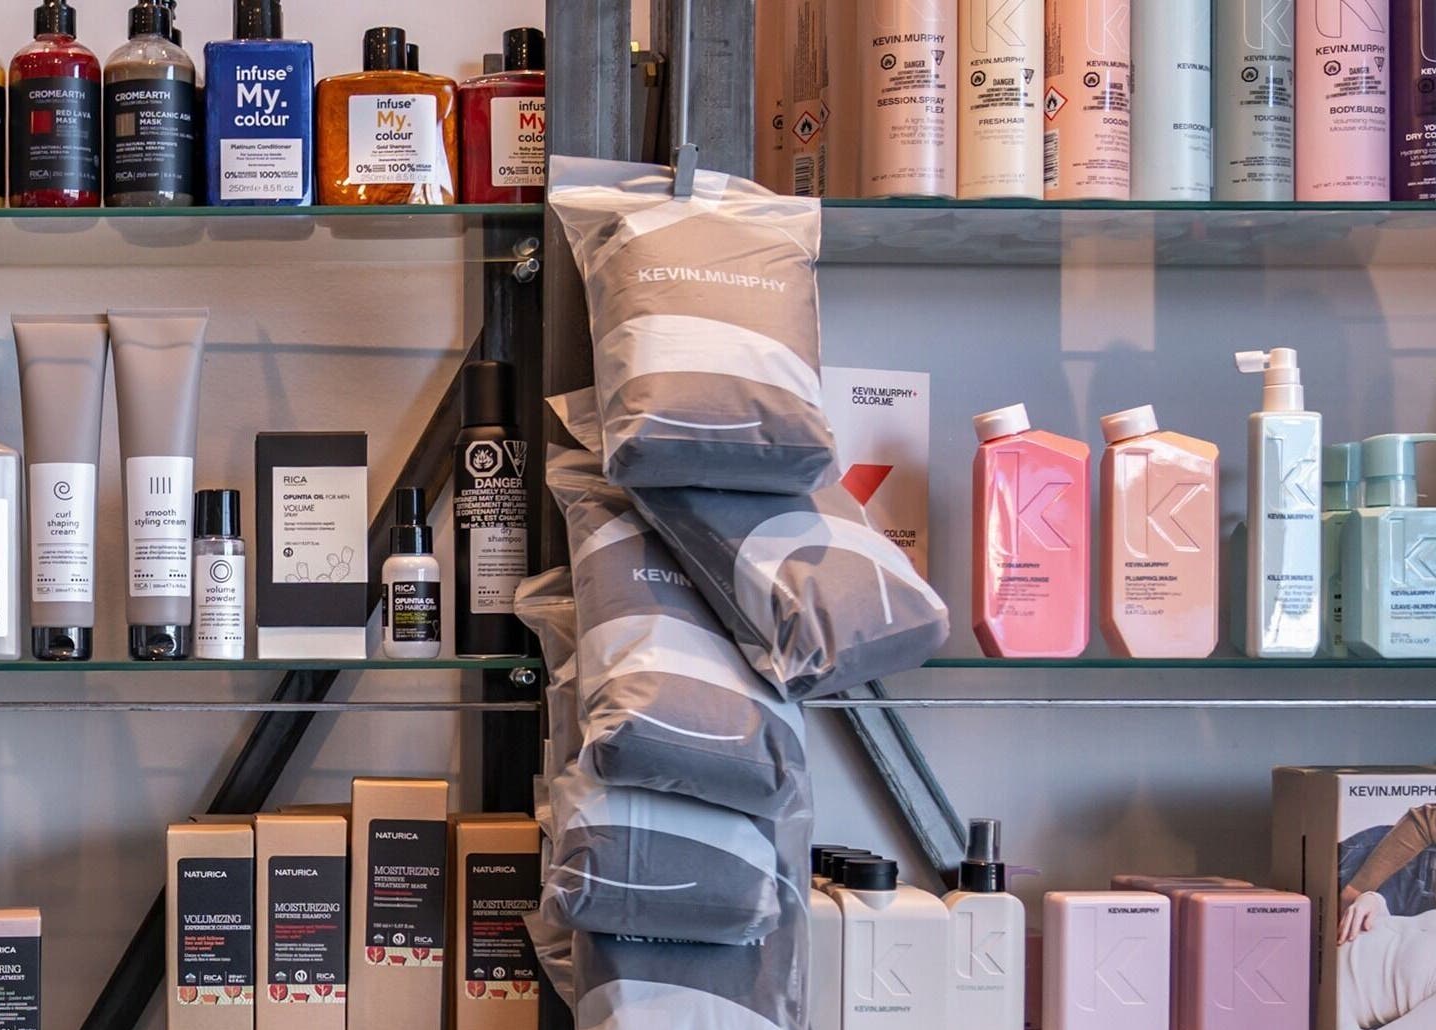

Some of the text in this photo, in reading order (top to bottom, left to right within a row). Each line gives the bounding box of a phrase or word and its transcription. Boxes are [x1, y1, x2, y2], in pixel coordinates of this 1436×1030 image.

[873, 35, 945, 47] KEVIN.MURPHY
[1316, 44, 1386, 56] KEVIN.MURPHY
[237, 65, 287, 81] infuse
[30, 89, 85, 100] CROMEARTH
[116, 92, 170, 101] CROMEARTH
[237, 82, 288, 113] My.
[377, 98, 412, 109] infuse
[140, 111, 176, 120] VOLCANIC
[235, 111, 289, 128] colour
[377, 110, 411, 130] My.
[376, 130, 413, 141] colour
[388, 163, 416, 173] 100%
[638, 267, 786, 293] KEVIN.MURPHY
[475, 477, 522, 488] DANGER
[283, 503, 314, 512] VOLUME
[145, 509, 176, 517] smooth
[47, 520, 80, 529] shaping
[134, 518, 160, 527] styling
[51, 528, 76, 536] cream
[206, 586, 236, 594] volume
[396, 584, 416, 593] RICA
[206, 594, 236, 603] powder
[1349, 785, 1436, 797] KEVIN.MURPH
[375, 832, 418, 840] NATURICA
[374, 866, 439, 876] MOISTURIZING
[275, 903, 339, 912] MOISTURIZING
[473, 899, 537, 909] MOISTURIZING
[184, 915, 241, 924] VOLUMIZING
